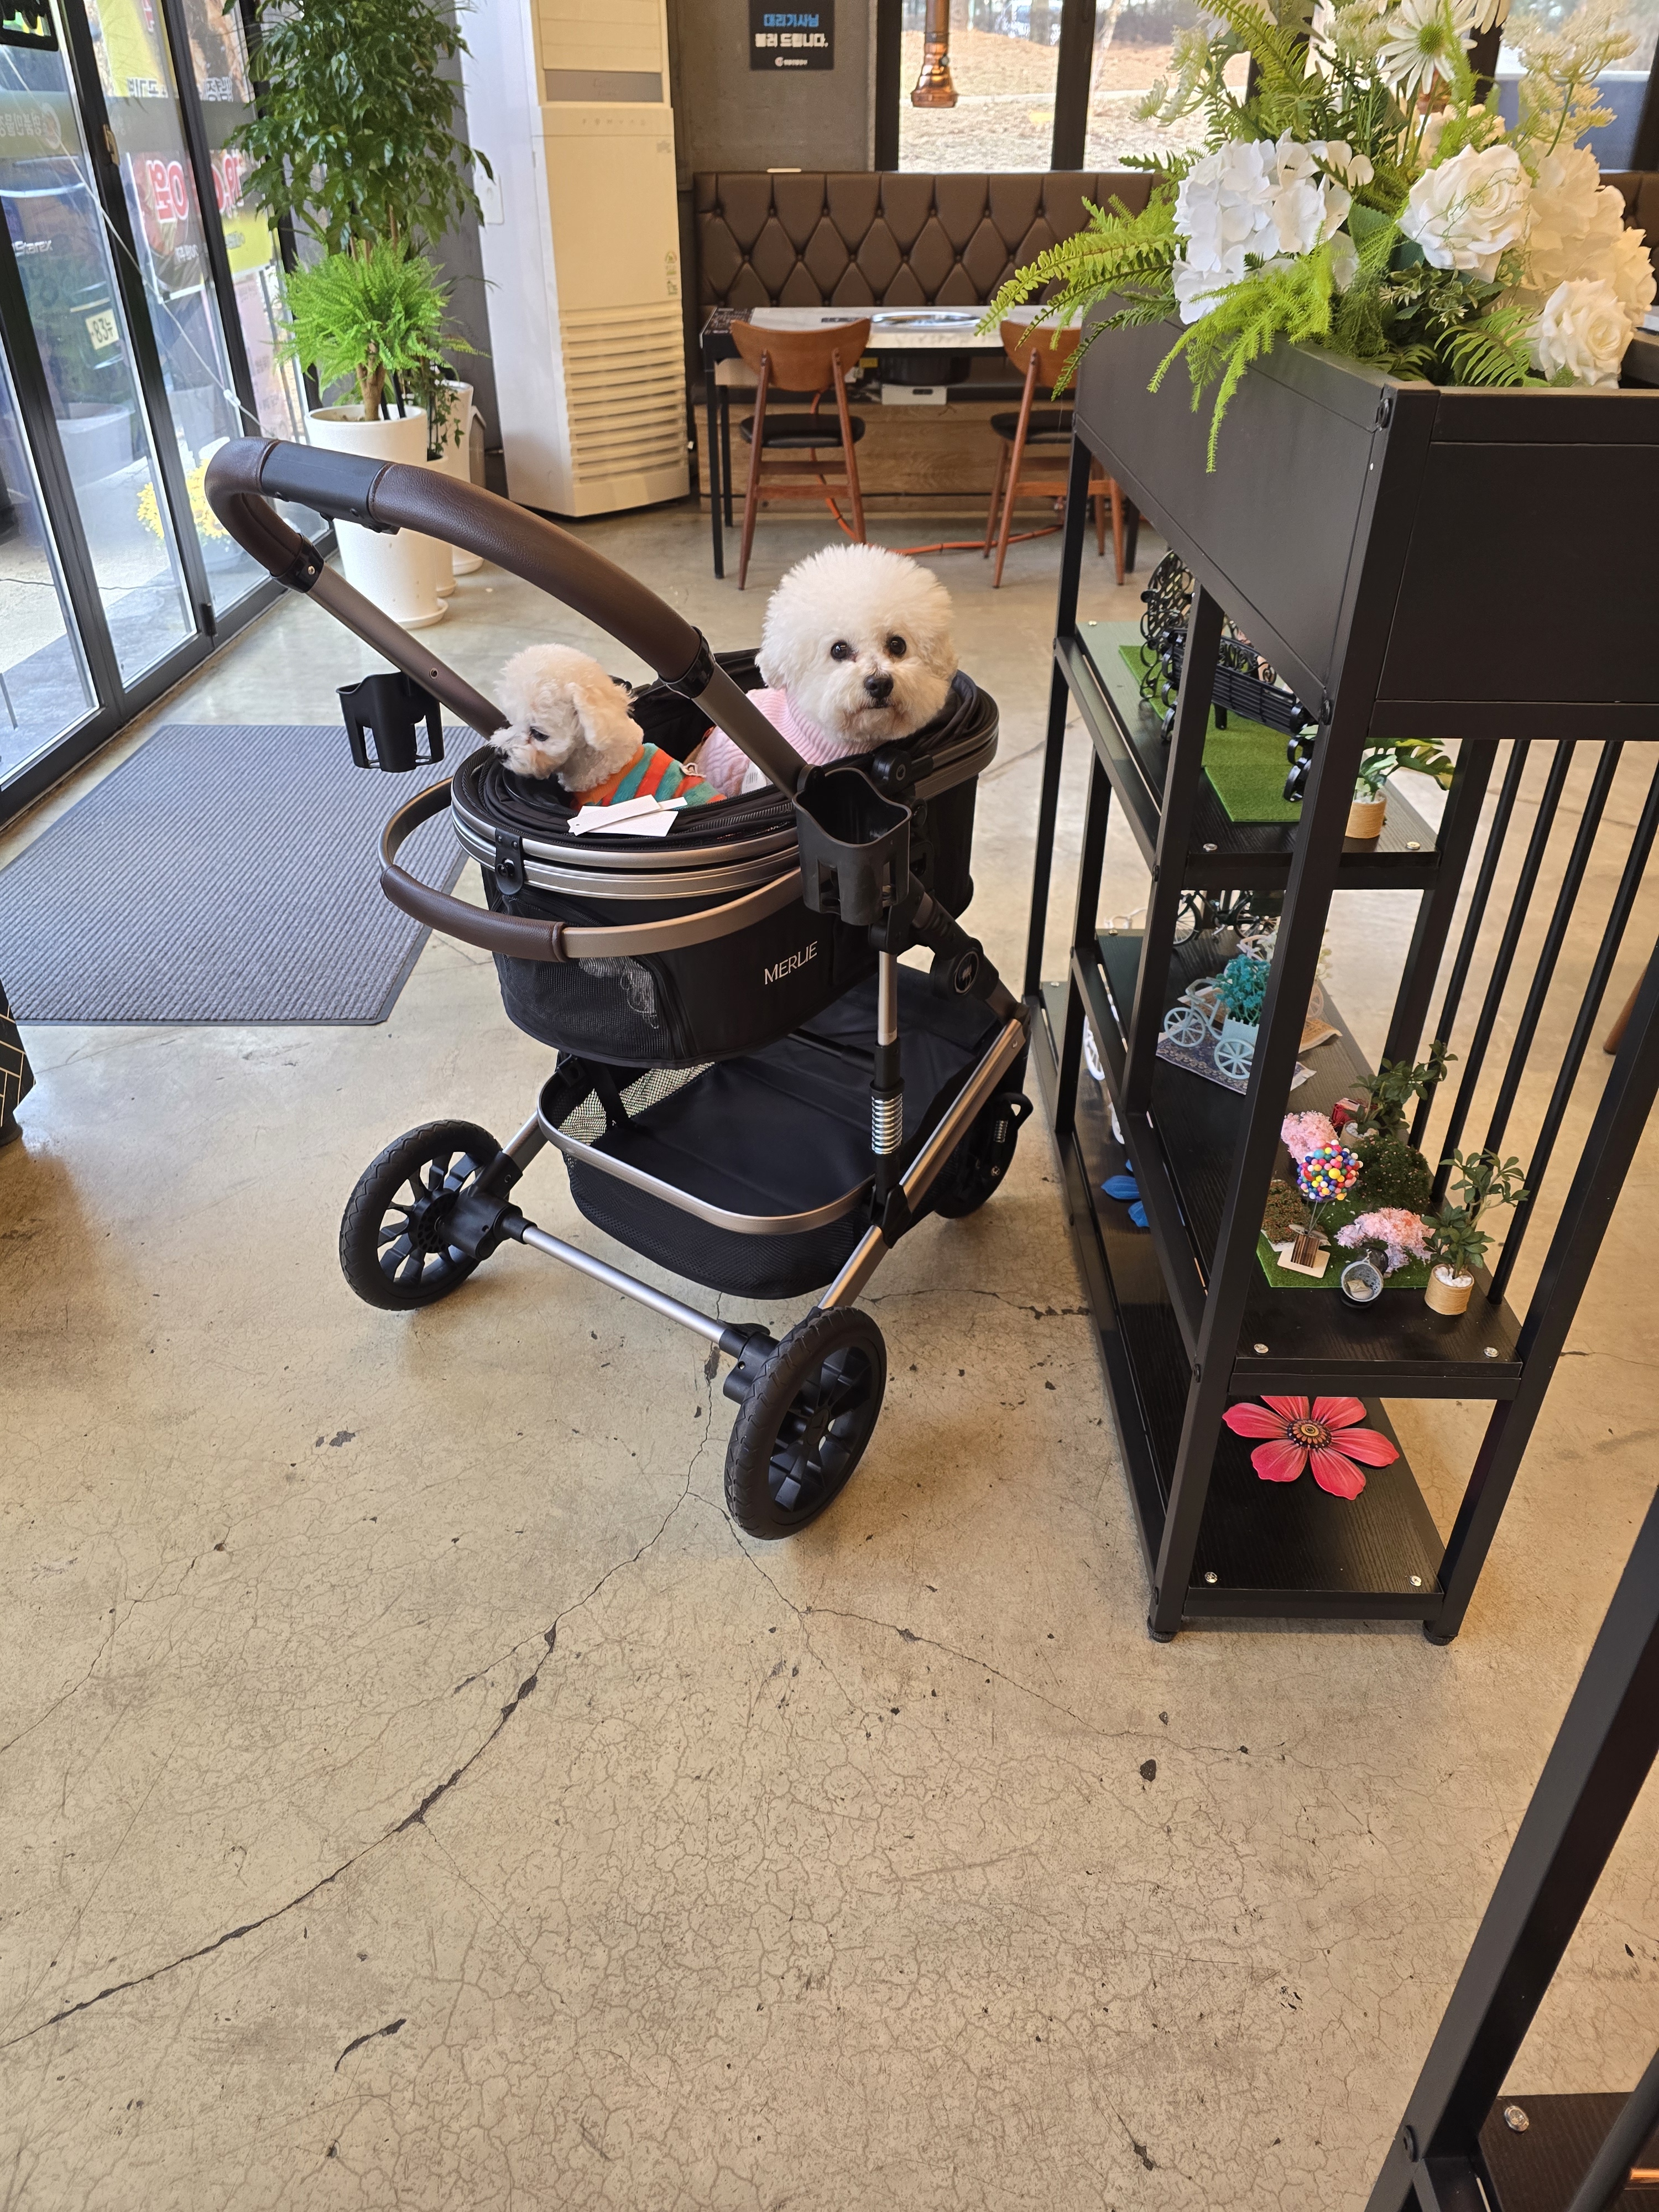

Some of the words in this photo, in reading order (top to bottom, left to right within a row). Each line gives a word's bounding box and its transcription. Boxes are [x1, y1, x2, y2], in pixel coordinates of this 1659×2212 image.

[763, 13, 819, 28] 대리기사님
[755, 33, 778, 48] 불러
[780, 33, 829, 48] 드립니다.
[764, 941, 818, 985] MERLIE
